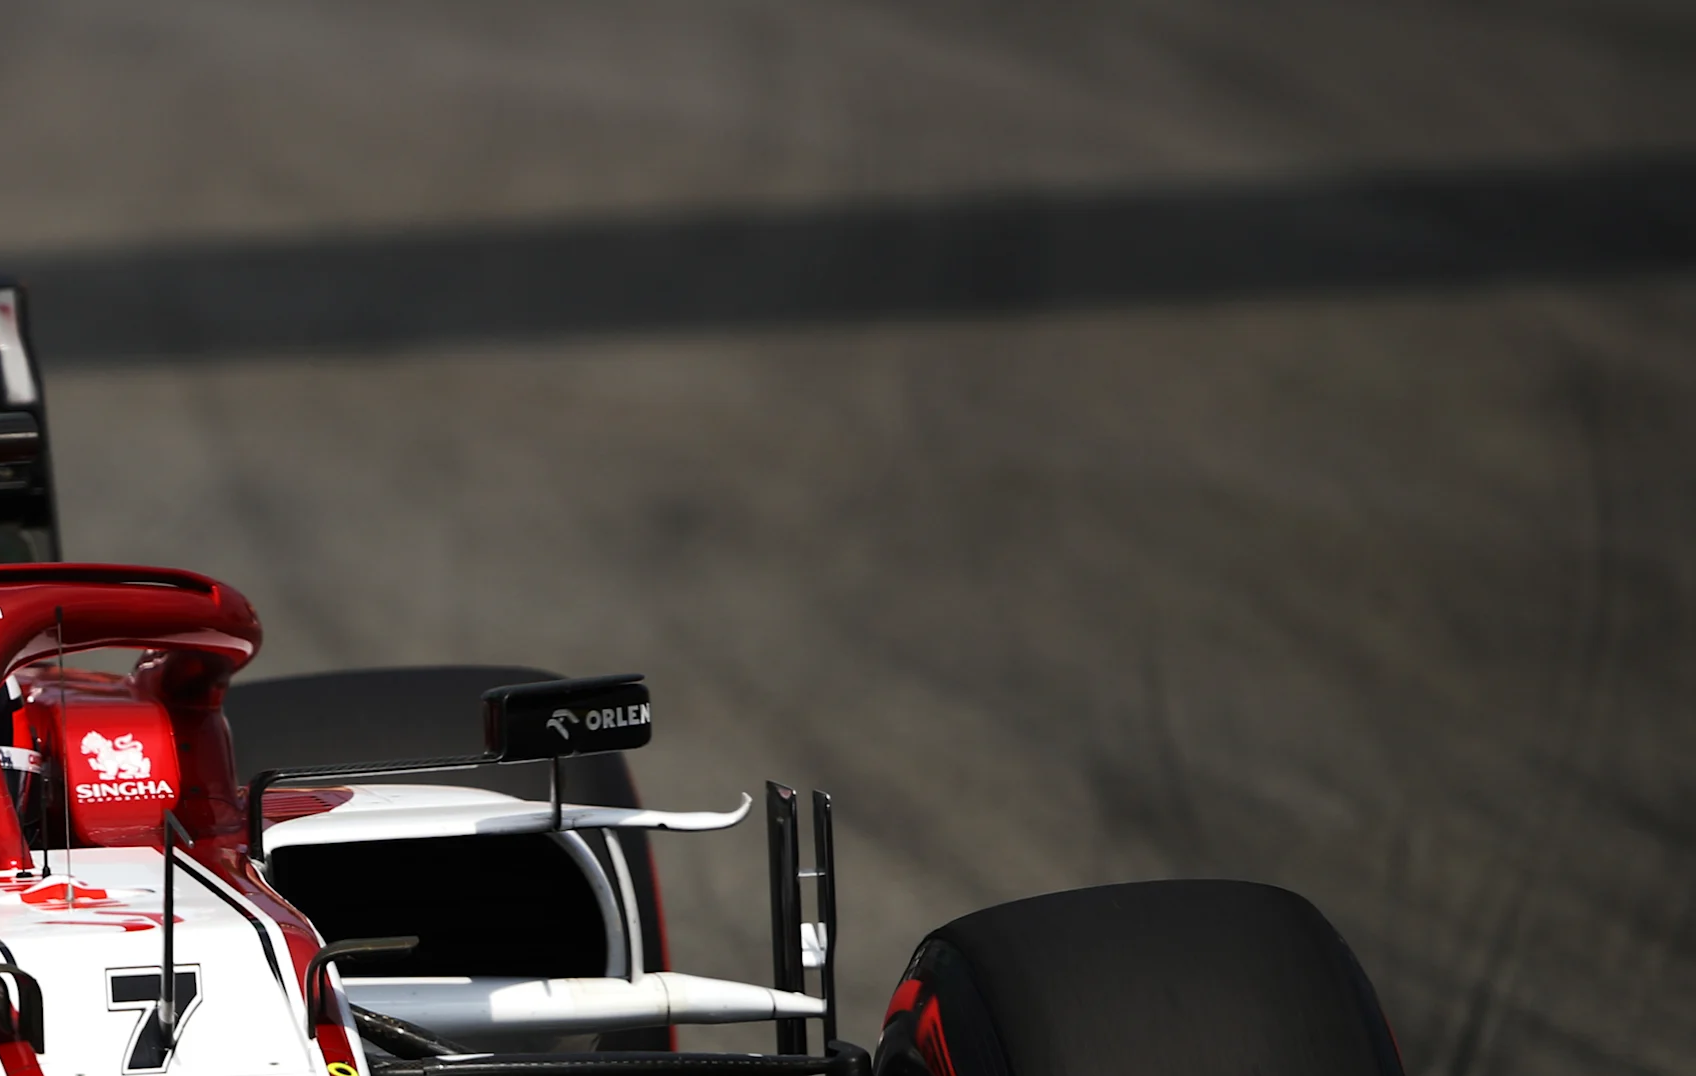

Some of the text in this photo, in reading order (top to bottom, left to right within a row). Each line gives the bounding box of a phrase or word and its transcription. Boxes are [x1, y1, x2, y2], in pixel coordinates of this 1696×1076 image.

[585, 702, 651, 731] ORLEN
[75, 780, 173, 799] SINGHA
[105, 963, 203, 1076] 7
